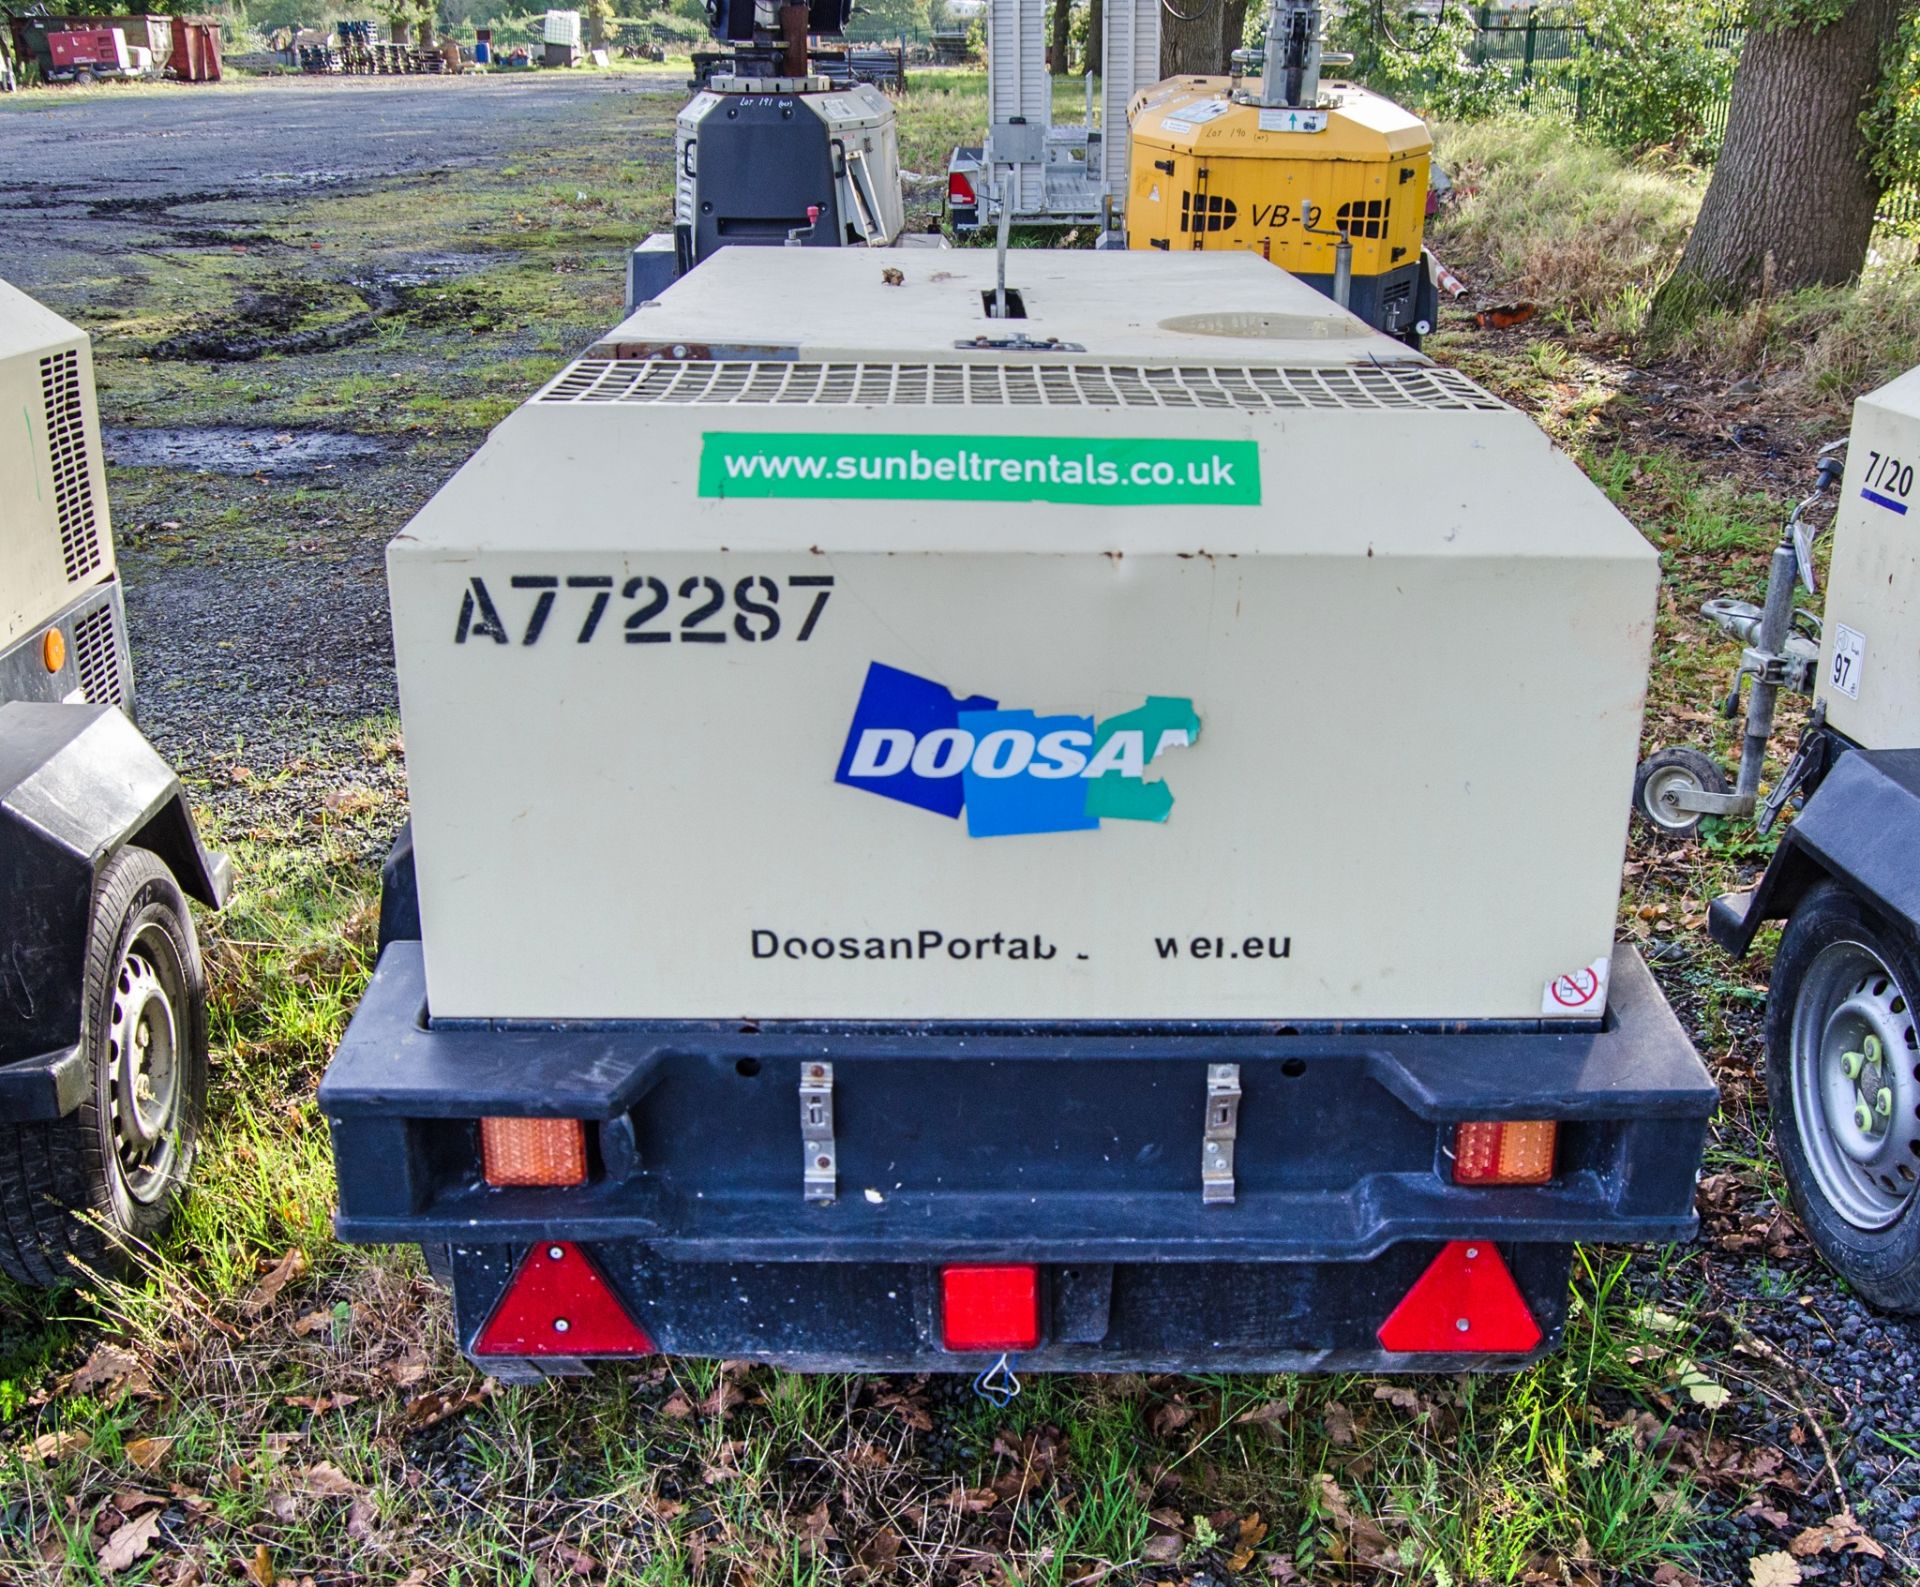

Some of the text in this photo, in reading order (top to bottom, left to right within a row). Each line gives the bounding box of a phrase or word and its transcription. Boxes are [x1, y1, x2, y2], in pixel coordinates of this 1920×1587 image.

[724, 450, 1236, 486] www.sunbeltrentals.co.uk
[1864, 450, 1914, 498] 7/20
[455, 575, 834, 646] A772287
[1833, 652, 1851, 687] 97
